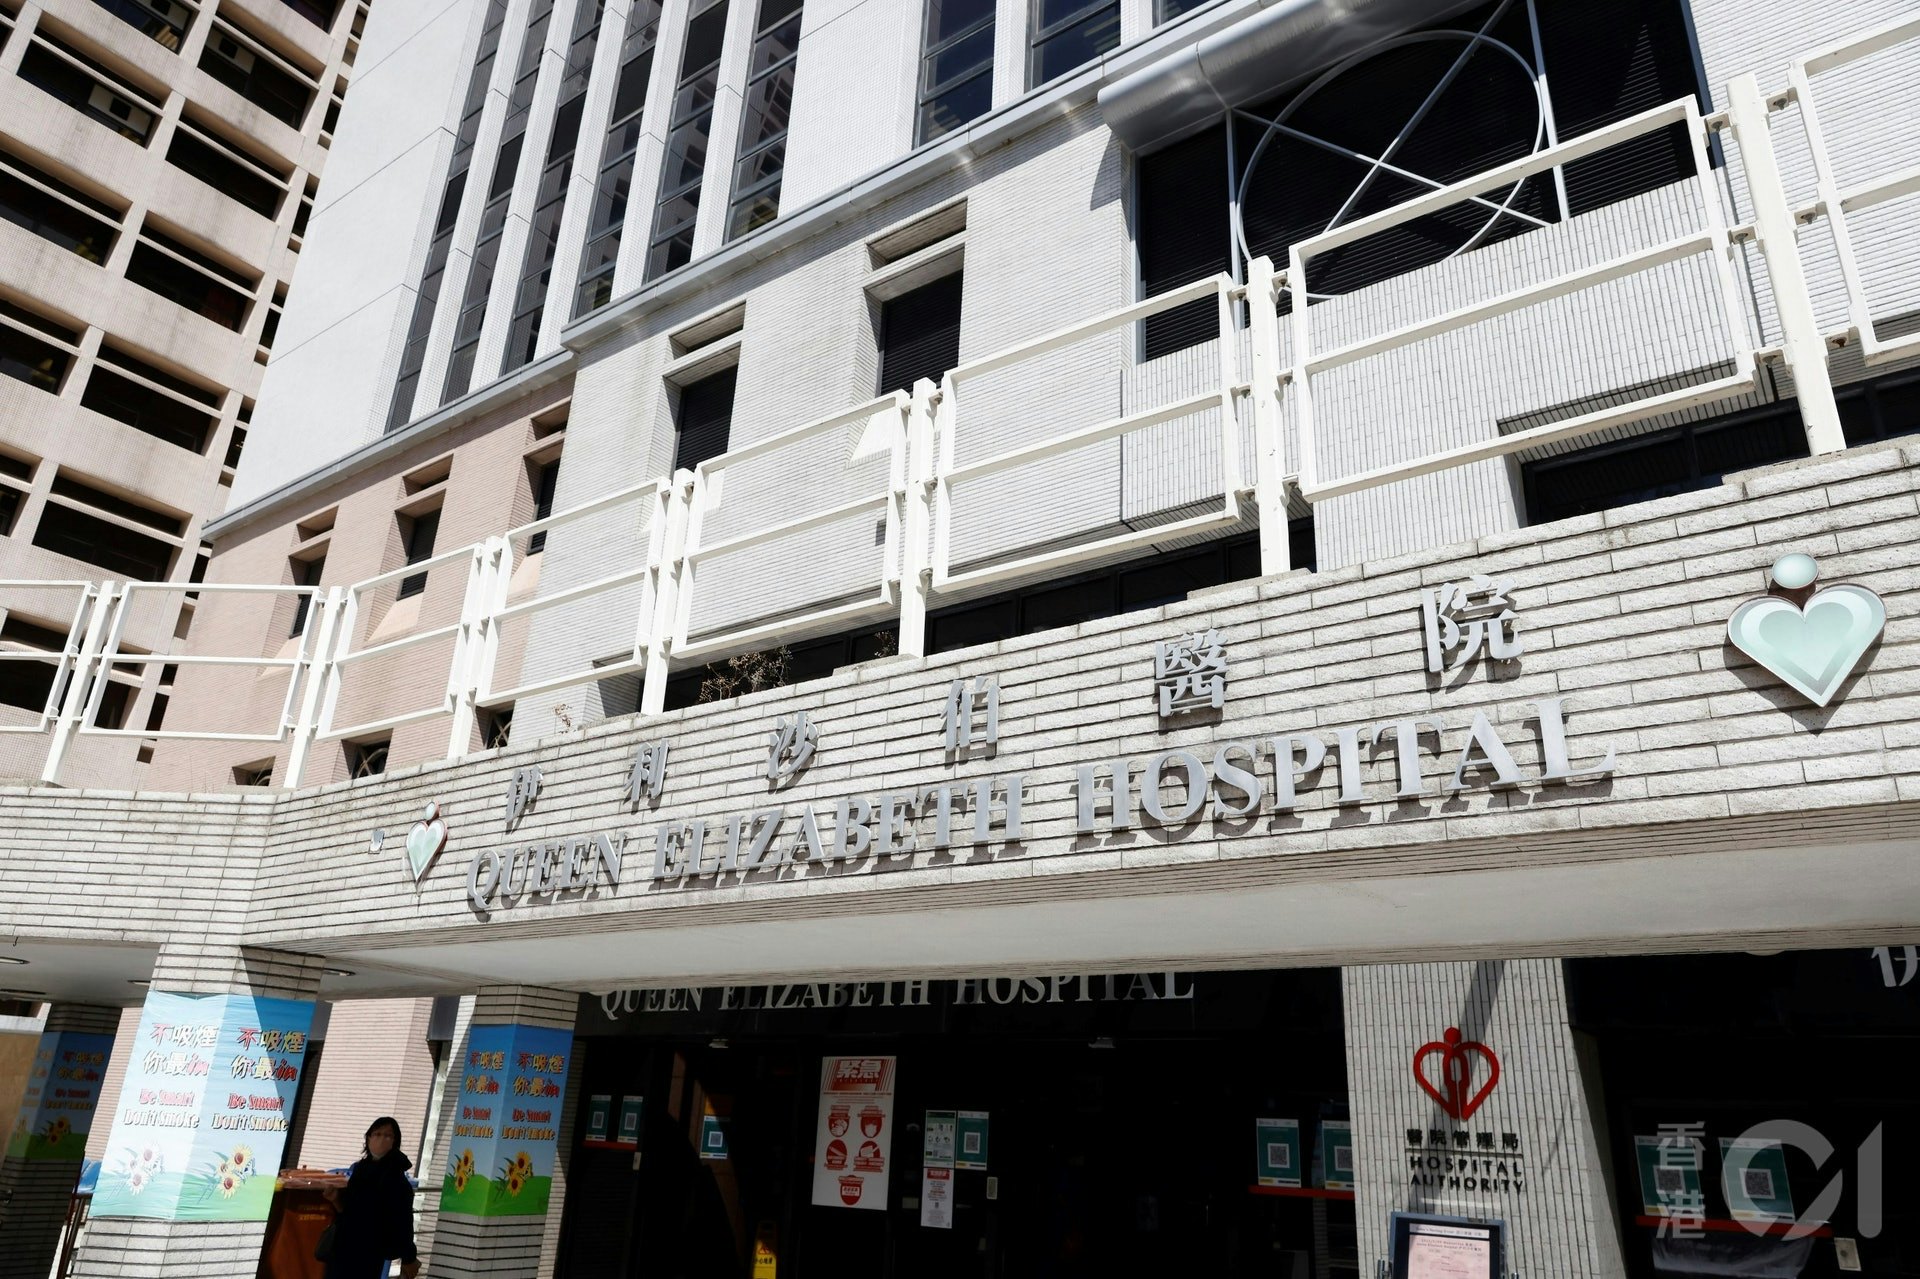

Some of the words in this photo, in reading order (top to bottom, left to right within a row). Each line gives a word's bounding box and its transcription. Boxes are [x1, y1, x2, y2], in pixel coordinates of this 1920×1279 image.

[504, 574, 1524, 823] 伊利沙伯醫院
[467, 832, 628, 909] QUEEN
[651, 775, 1026, 878] ELIZABETH
[1075, 698, 1616, 832] HOSPITAL
[600, 987, 704, 1020] QUEEN
[718, 979, 931, 1011] ELIZABETH
[151, 1023, 219, 1048] 不吸煙
[237, 1027, 306, 1054] 不吸煙
[230, 1055, 298, 1081] 你最in
[516, 1052, 565, 1074] 不吸煙
[836, 1059, 882, 1079] 緊急
[139, 1088, 157, 1104] Be
[227, 1093, 247, 1109] Be
[248, 1094, 285, 1111] Smart
[211, 1113, 248, 1130] Don't
[1407, 1129, 1519, 1151] 醫院管理局
[1410, 1156, 1522, 1177] HOSPITAL
[1411, 1174, 1523, 1195] AUTHORITY
